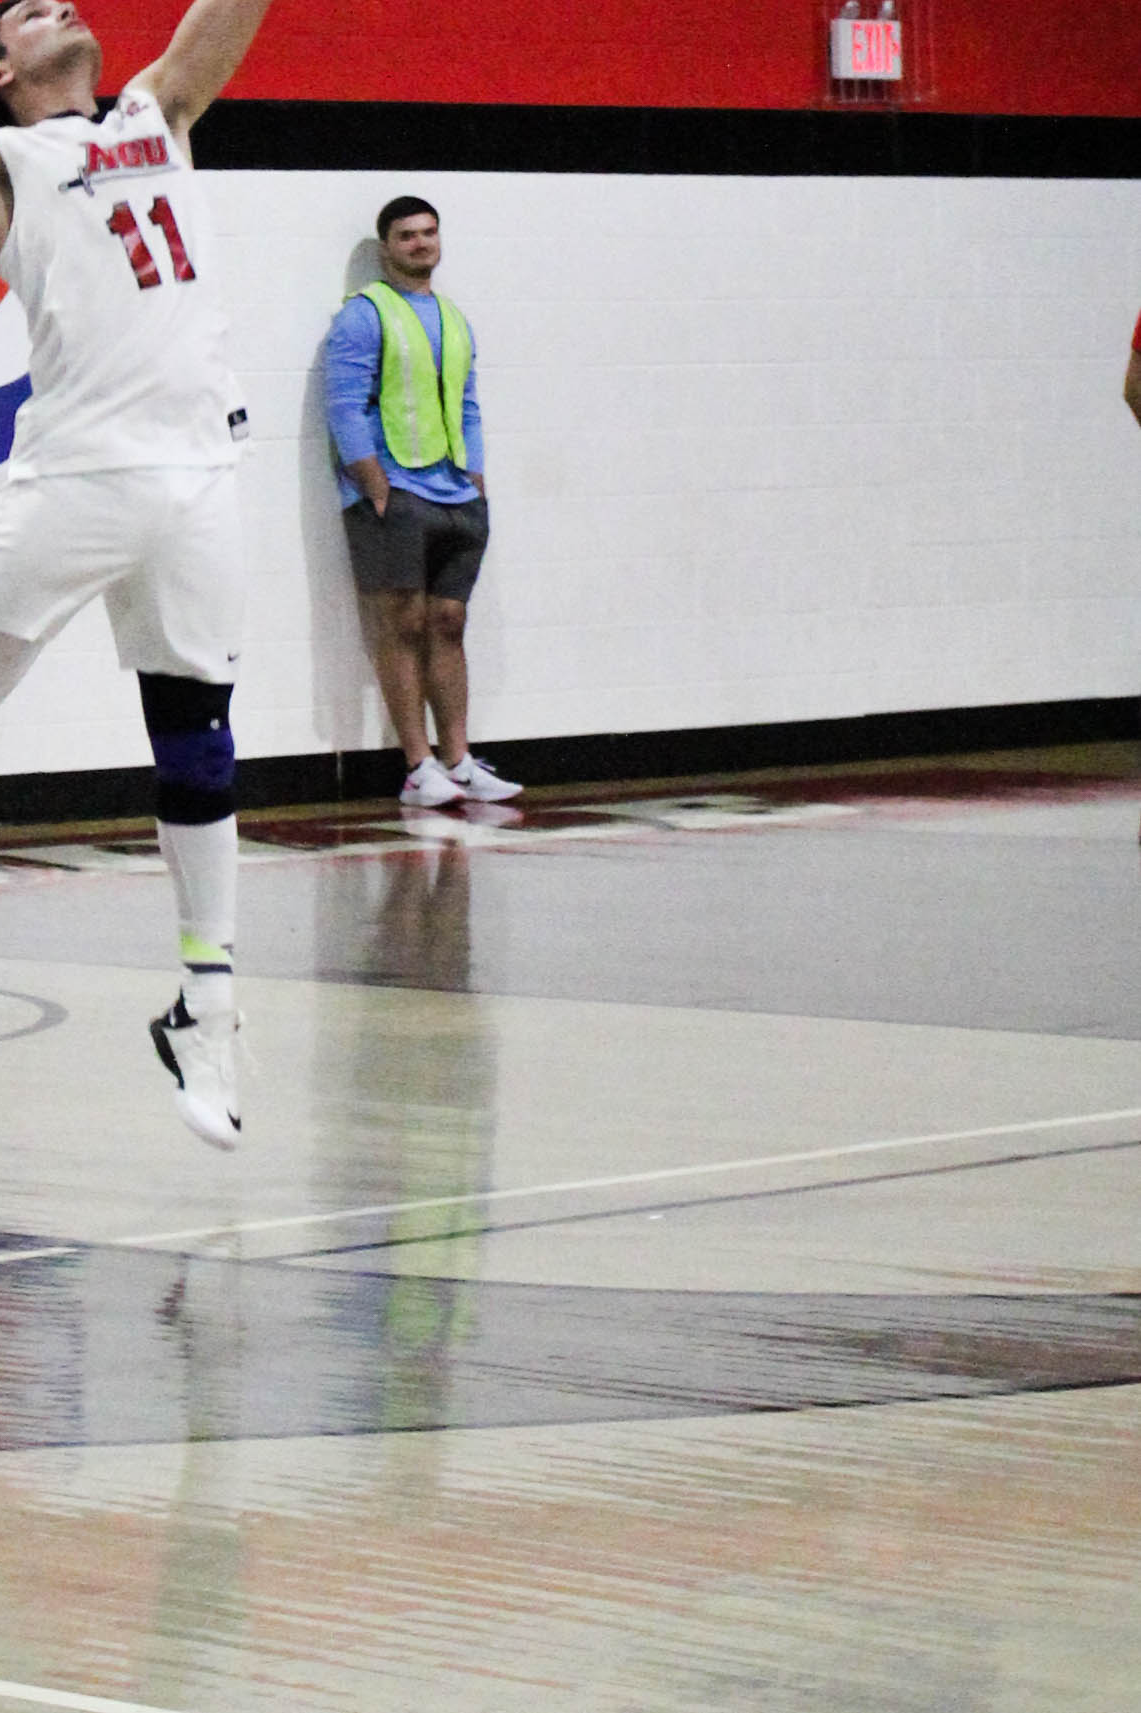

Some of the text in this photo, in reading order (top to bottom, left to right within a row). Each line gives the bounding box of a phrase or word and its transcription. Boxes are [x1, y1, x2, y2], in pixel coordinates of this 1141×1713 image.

[852, 21, 894, 74] EXIT
[84, 136, 170, 175] NGU
[106, 194, 199, 290] 11
